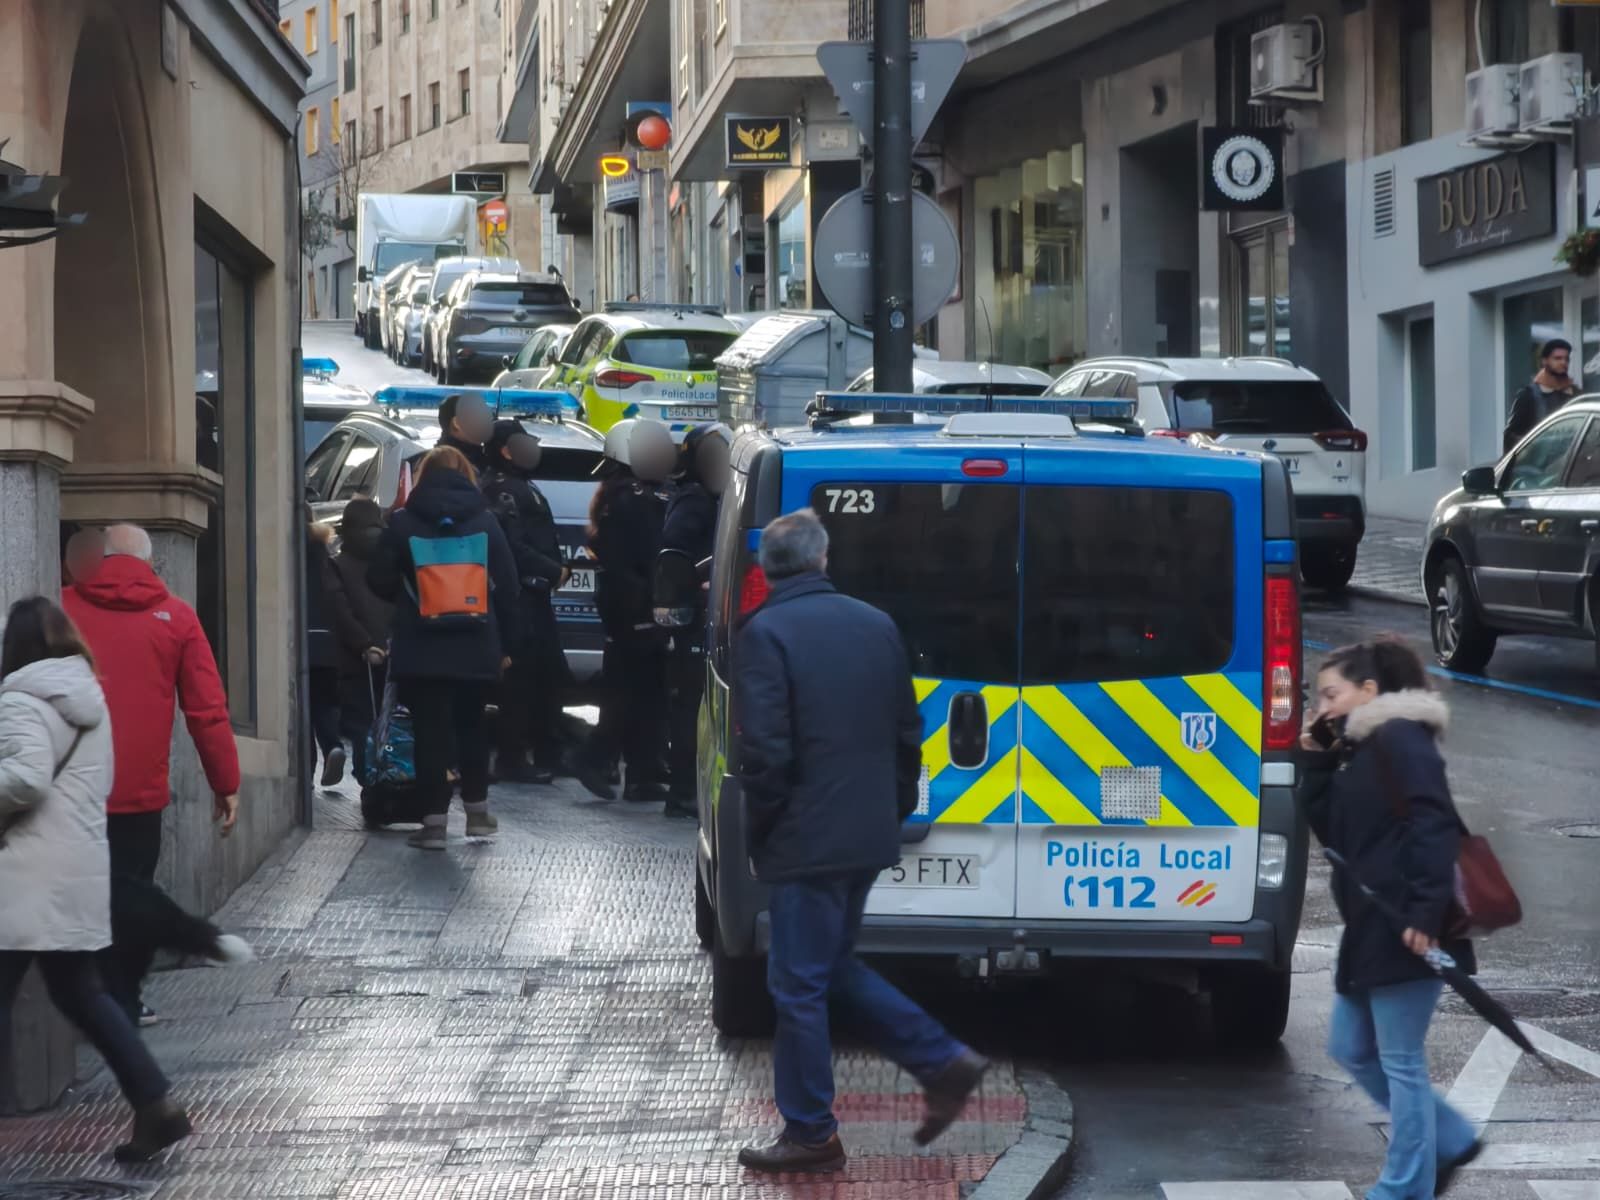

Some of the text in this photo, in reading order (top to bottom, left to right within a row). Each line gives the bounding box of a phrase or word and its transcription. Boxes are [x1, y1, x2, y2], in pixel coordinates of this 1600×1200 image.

[1438, 158, 1528, 233] BUDA
[826, 489, 875, 513] 723
[1047, 840, 1231, 870] Policía Local
[919, 858, 971, 884] FTX
[1078, 876, 1156, 909] 112
